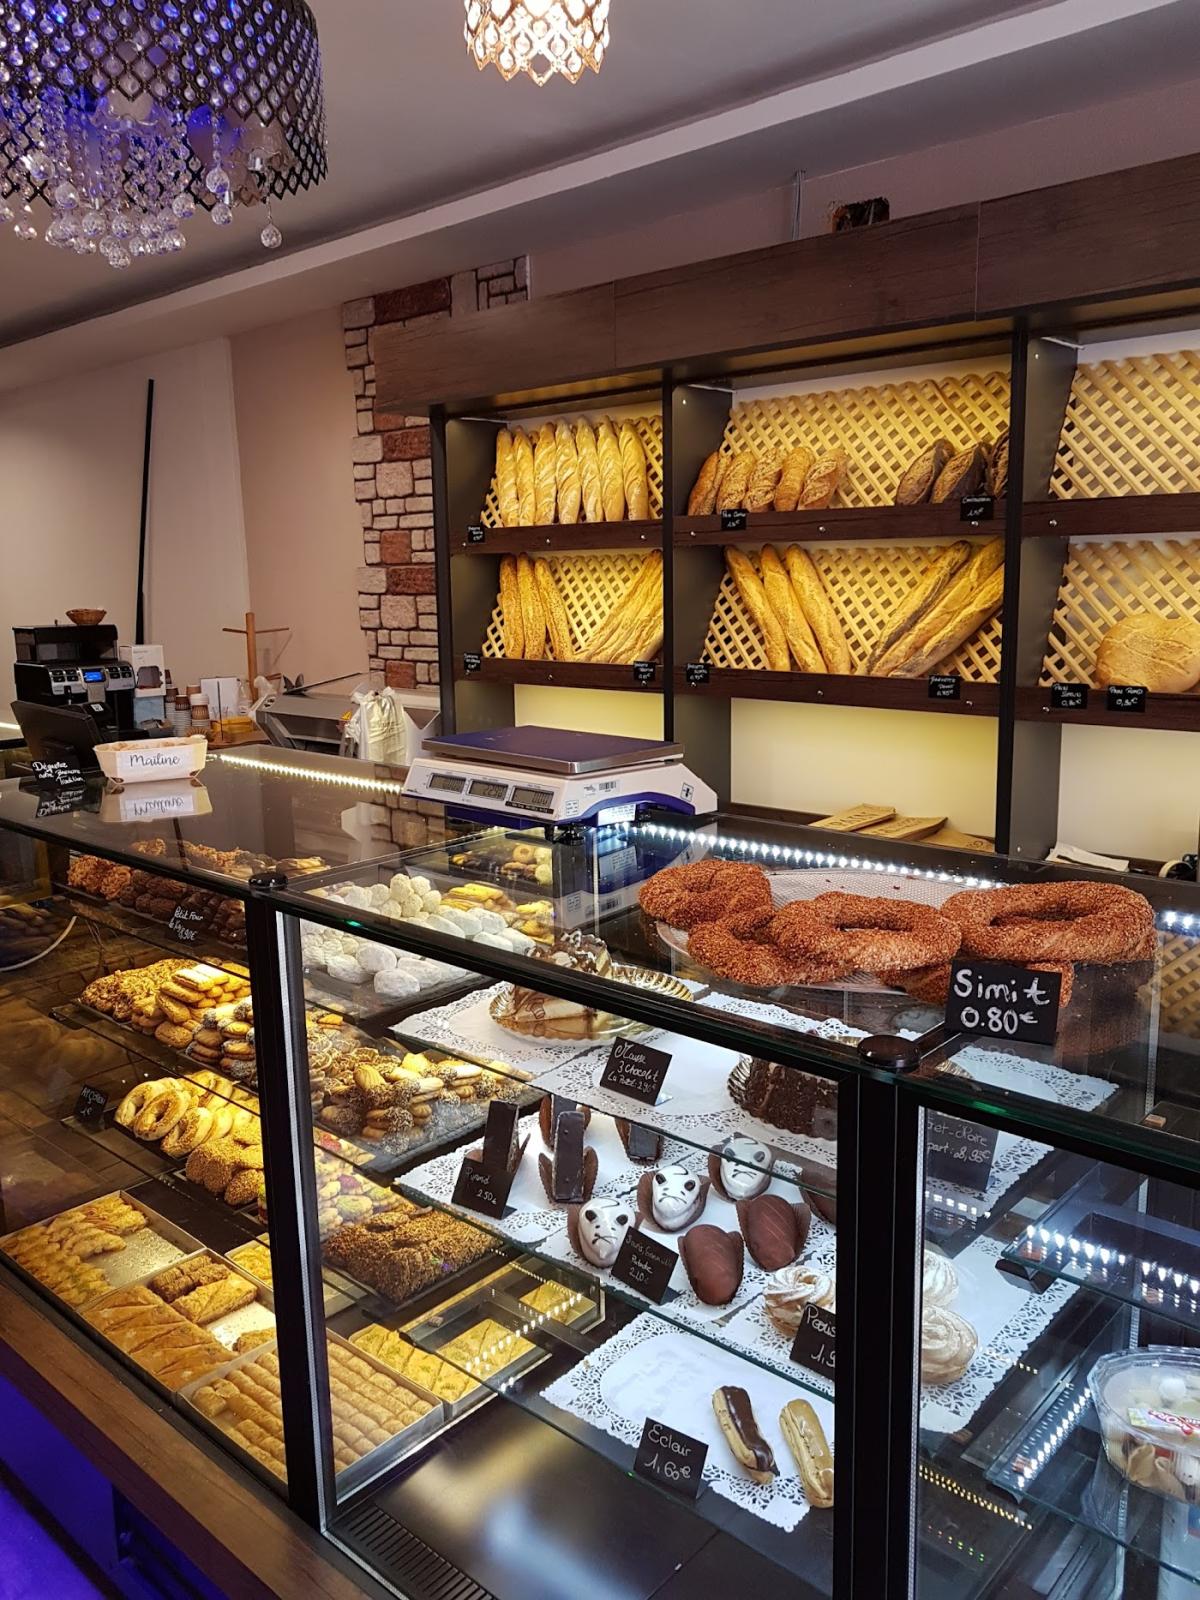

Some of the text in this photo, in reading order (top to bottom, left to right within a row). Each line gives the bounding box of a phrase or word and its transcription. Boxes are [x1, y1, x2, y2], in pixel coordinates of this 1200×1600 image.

[954, 968, 1050, 1006] Simit
[960, 1006, 1039, 1034] 0.80€
[648, 1424, 692, 1457] Eclair
